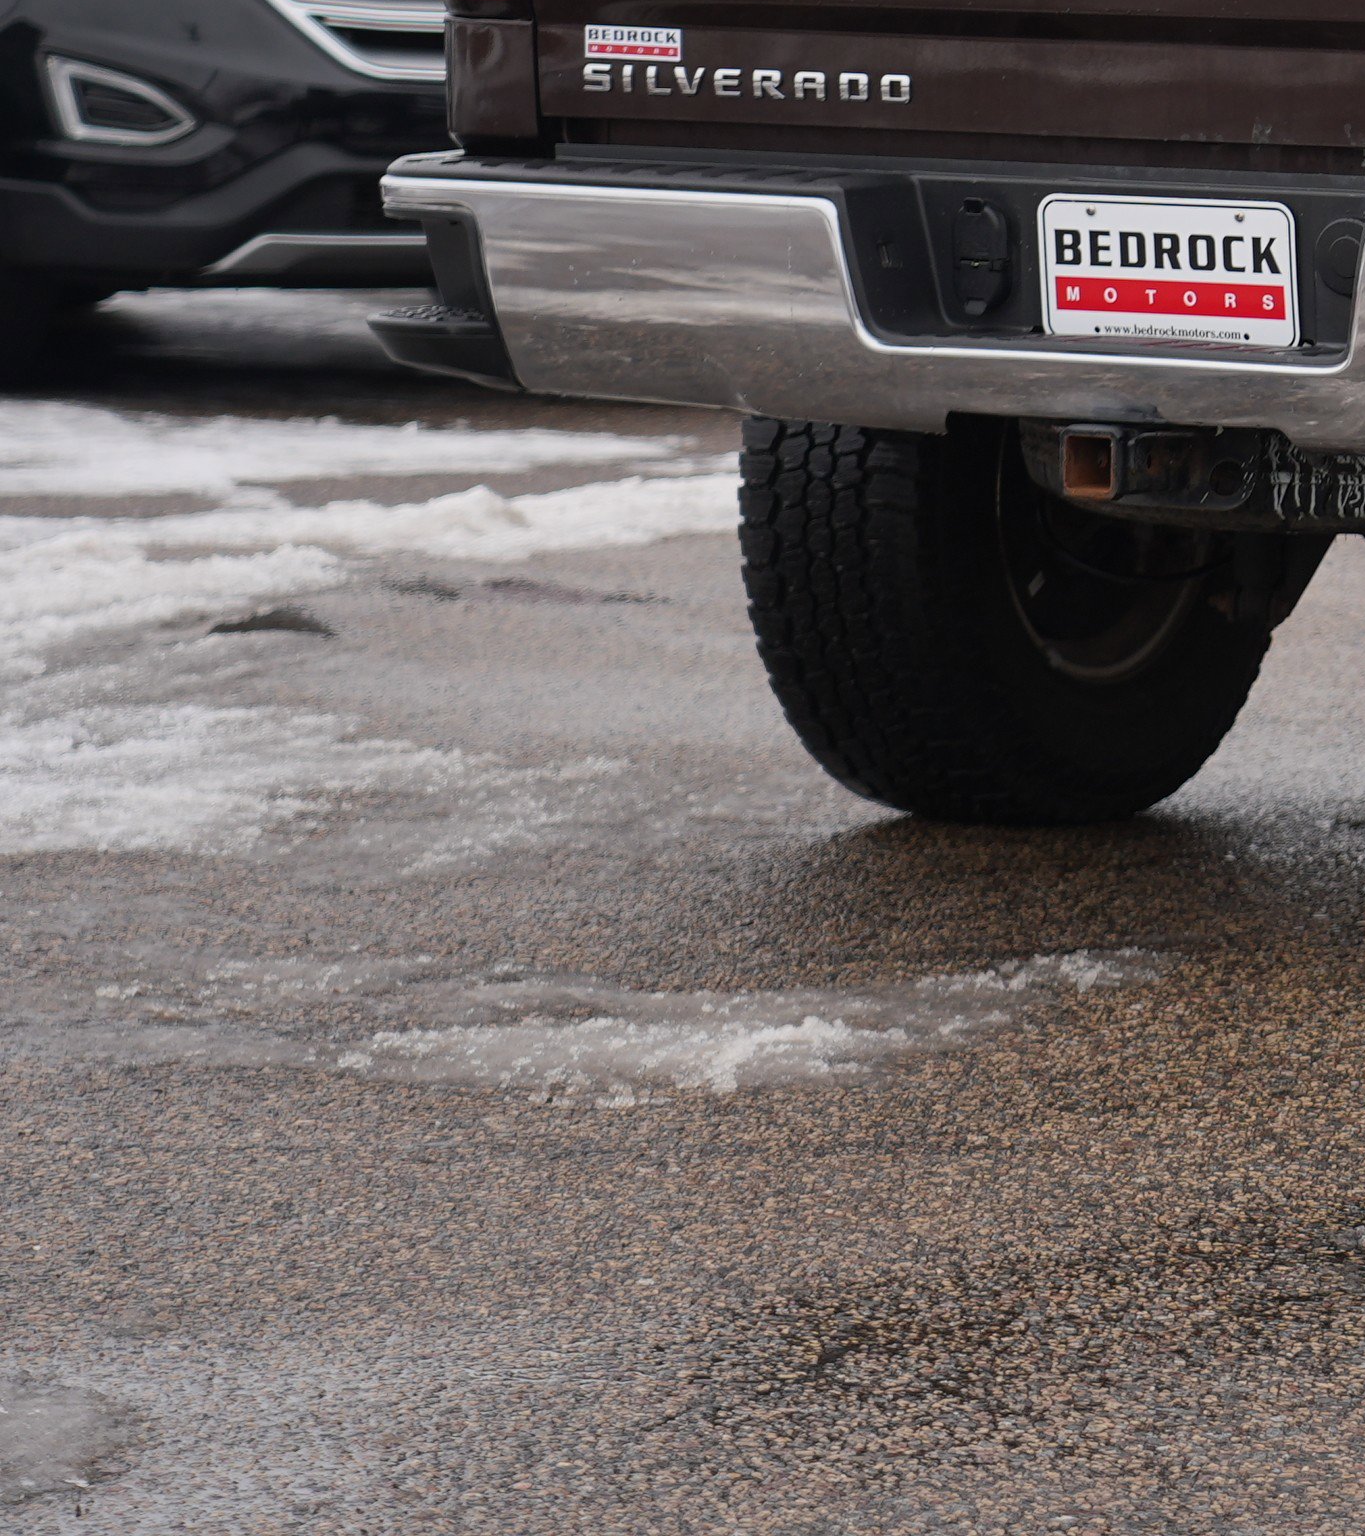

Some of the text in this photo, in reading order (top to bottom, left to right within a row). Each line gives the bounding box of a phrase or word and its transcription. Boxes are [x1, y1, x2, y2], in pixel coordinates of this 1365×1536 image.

[588, 28, 677, 43] BEDROCK
[591, 45, 675, 56] MOTORS
[583, 63, 912, 104] SILVERADO
[1054, 229, 1282, 275] BEDROCK
[1066, 286, 1275, 311] MOTORS
[1103, 324, 1242, 341] www.bedrockmotors.com
